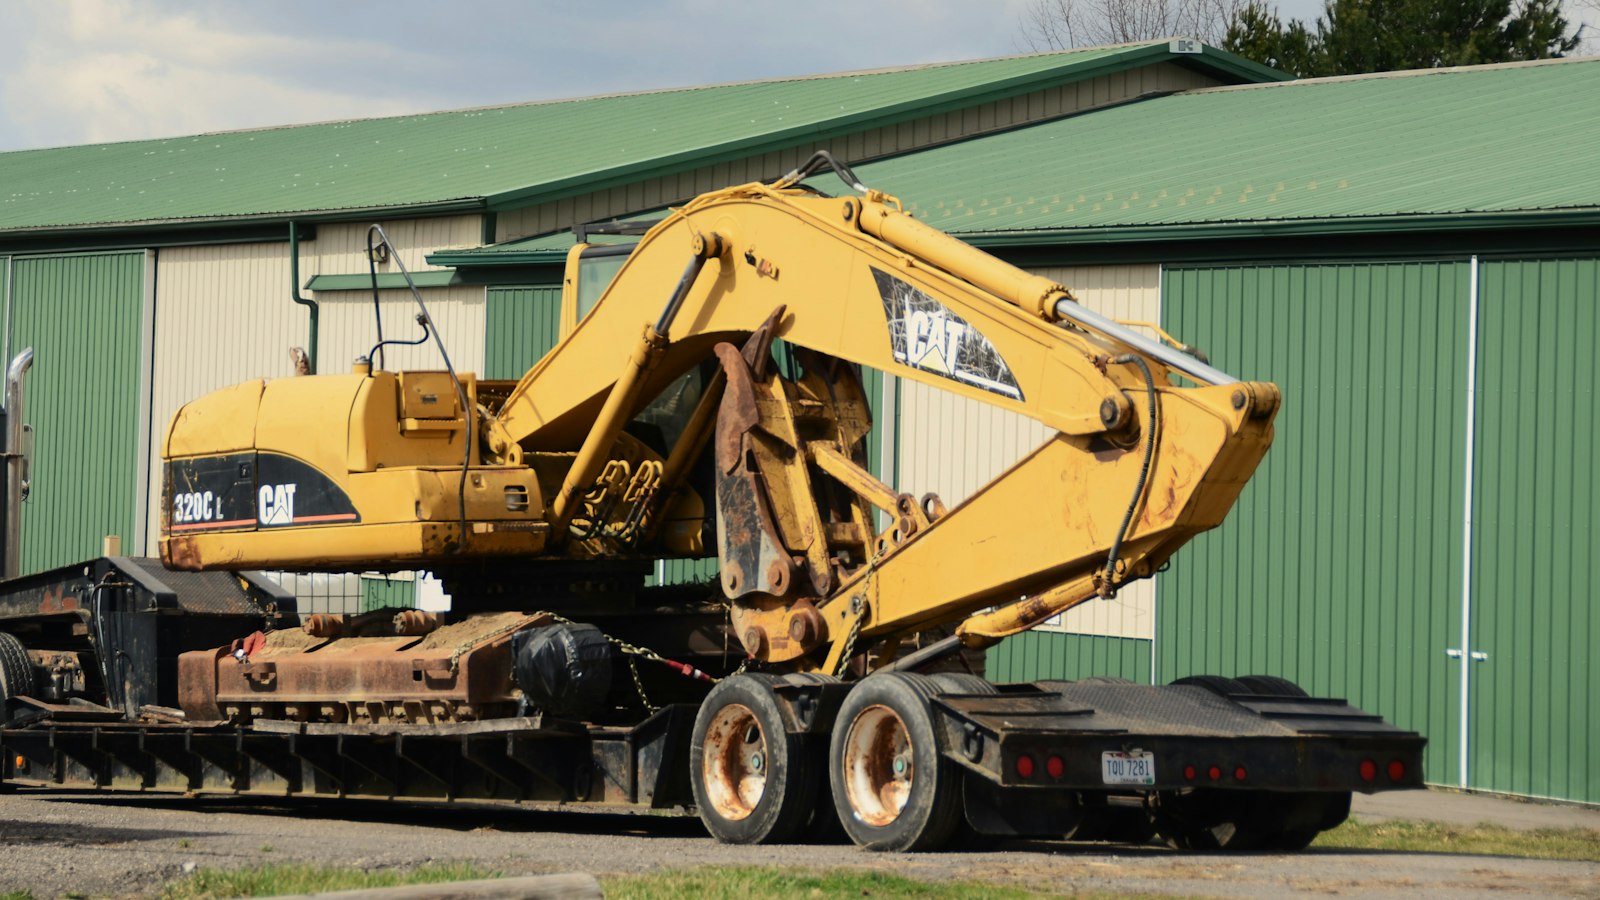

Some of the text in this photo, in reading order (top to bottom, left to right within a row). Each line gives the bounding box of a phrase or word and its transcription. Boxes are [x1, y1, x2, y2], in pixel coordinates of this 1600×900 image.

[906, 310, 964, 376] CAT
[175, 490, 224, 522] 320C L
[259, 483, 297, 525] CAT
[1127, 759, 1150, 776] 7281
